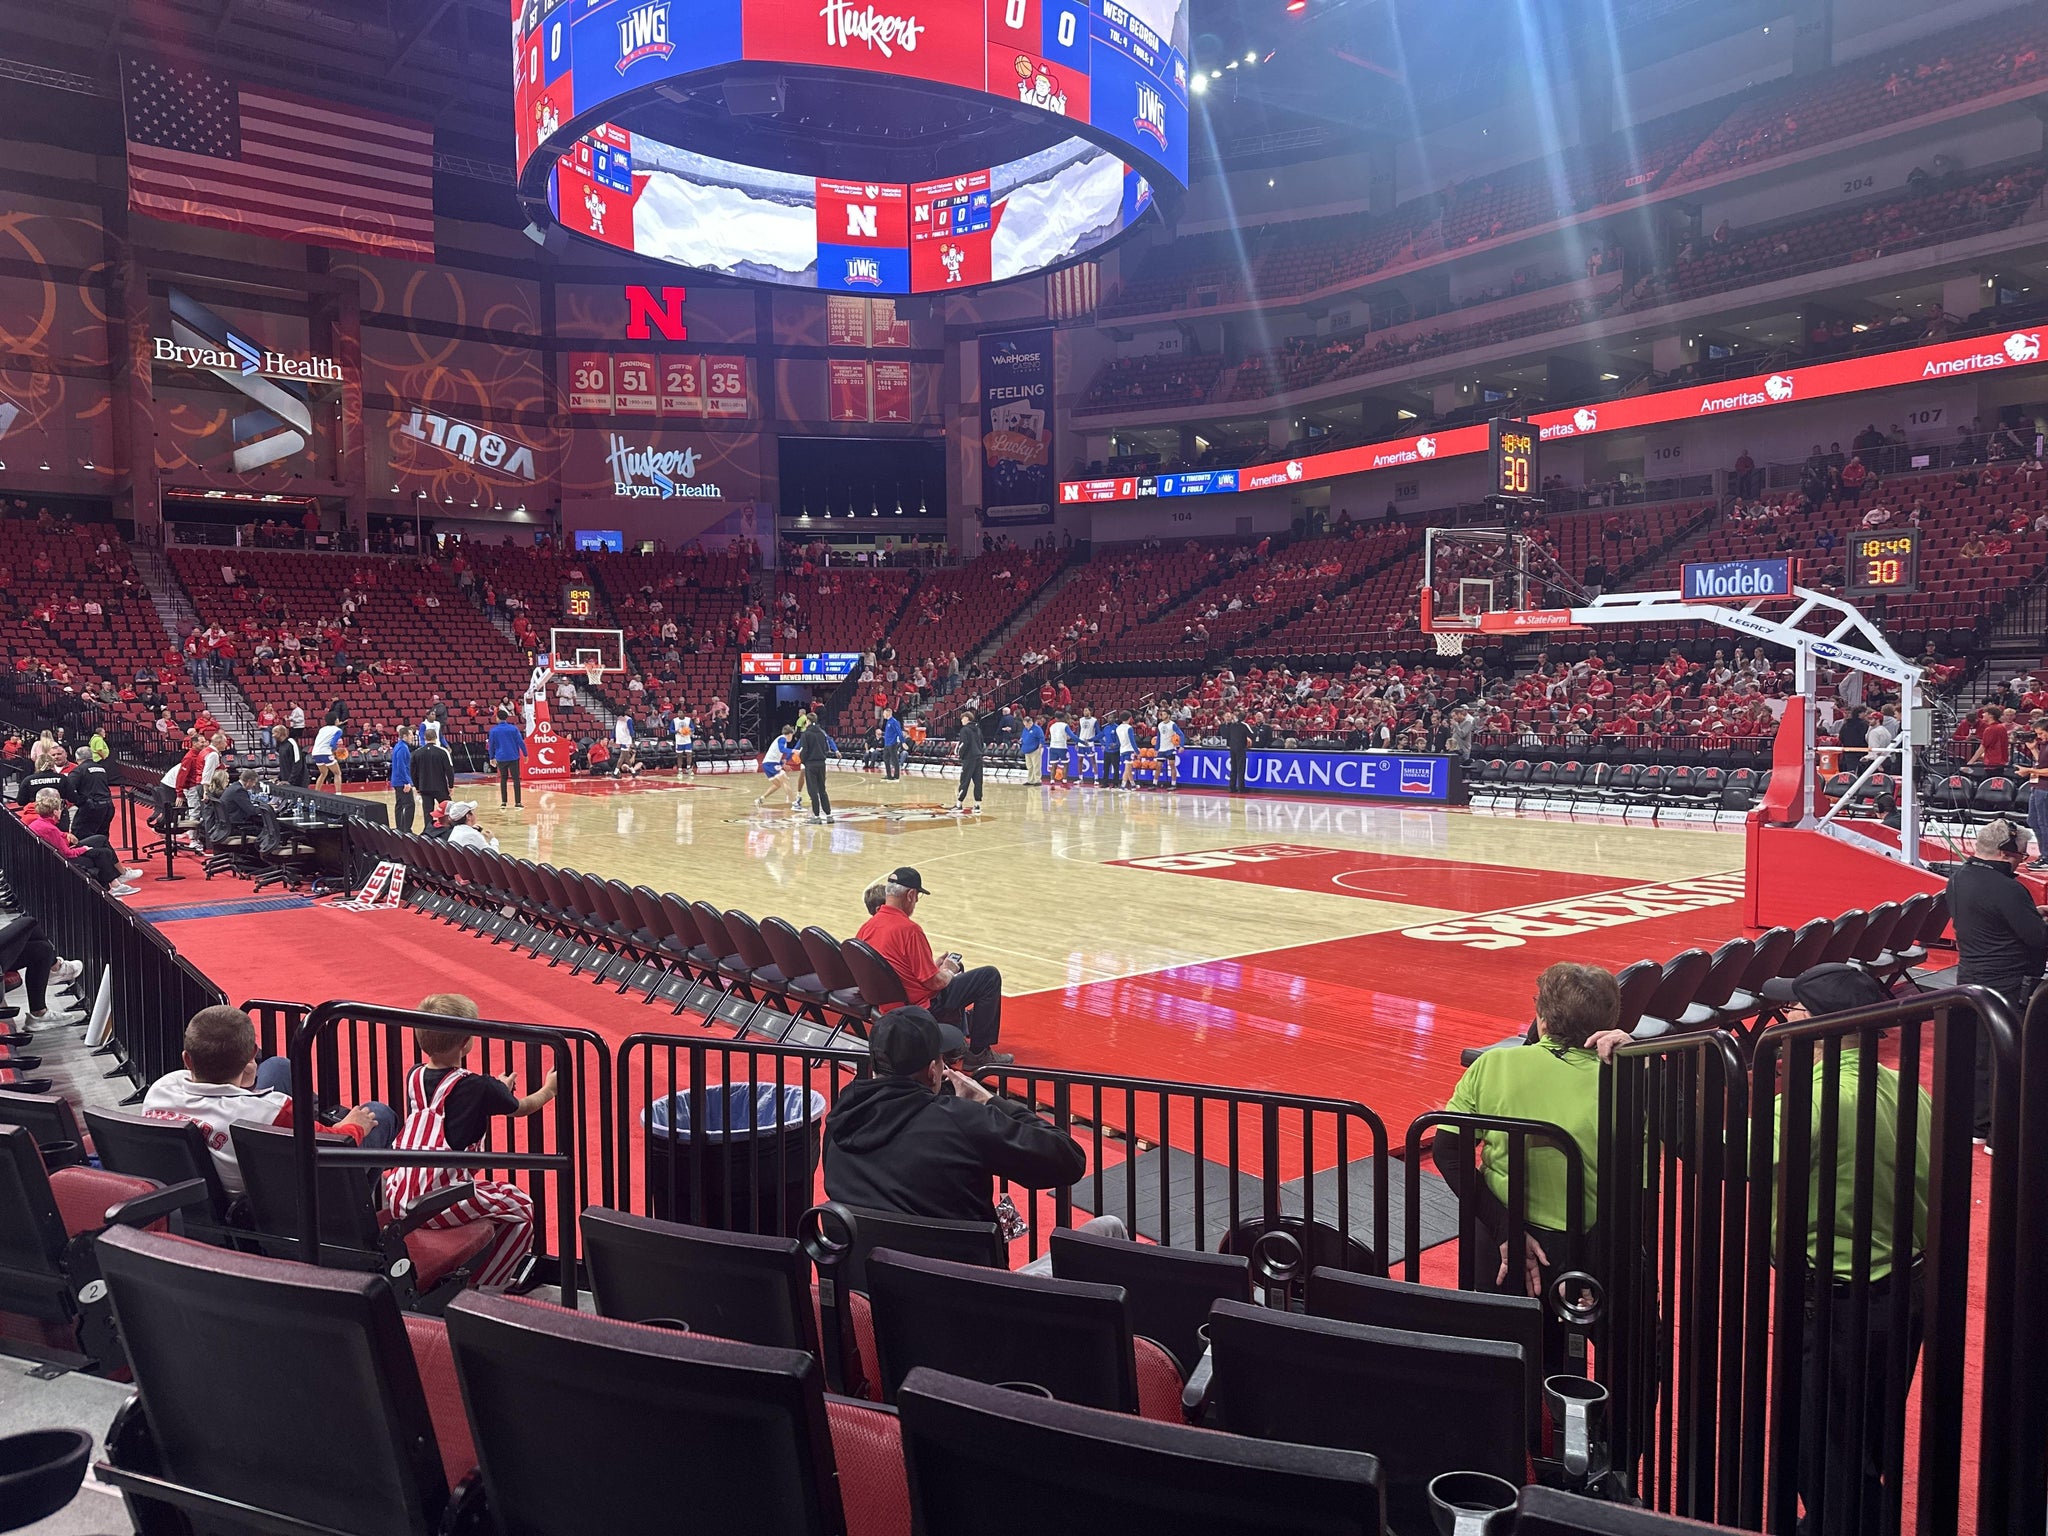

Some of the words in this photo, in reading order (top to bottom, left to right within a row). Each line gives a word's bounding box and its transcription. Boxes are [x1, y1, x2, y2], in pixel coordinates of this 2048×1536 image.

[621, 5, 666, 56] UWG
[819, 0, 925, 58] Huskers
[1057, 10, 1076, 47] 0
[1102, 0, 1127, 28] WEST
[1129, 13, 1159, 53] GEORGIA
[531, 46, 537, 84] 0
[551, 22, 562, 61] 0
[1138, 87, 1165, 134] UWG
[581, 148, 589, 163] 0
[598, 155, 606, 170] 0
[1844, 175, 1874, 193] 204
[914, 204, 929, 222] N
[938, 211, 947, 225] 0
[957, 207, 966, 222] 0
[846, 204, 878, 238] N
[848, 259, 877, 278] UWG
[625, 285, 688, 341] N
[1158, 340, 1178, 350] 201
[153, 337, 237, 369] Bryan
[264, 351, 344, 381] Health
[619, 361, 651, 369] JENNINGS
[991, 352, 1041, 365] WARHORSE
[1922, 353, 2004, 377] Ameritas
[713, 363, 738, 371] HOOPER
[575, 369, 604, 390] 30
[623, 370, 648, 392] 51
[667, 372, 696, 393] 23
[711, 373, 741, 394] 35
[989, 384, 1045, 400] FEELING
[571, 396, 582, 406] N
[617, 397, 627, 407] N
[664, 398, 674, 408] N
[710, 400, 720, 409] N
[1700, 391, 1766, 413] Ameritas
[1908, 408, 1943, 426] 107
[1540, 424, 1574, 438] eritas
[991, 434, 1044, 463] Lucky?
[1654, 445, 1681, 460] 106
[605, 432, 702, 486] Huskers
[1373, 450, 1417, 467] Ameritas
[1250, 472, 1287, 488] Ameritas
[1504, 456, 1528, 492] 30
[614, 482, 660, 499] Bryan
[674, 483, 722, 498] Health
[1122, 482, 1132, 495] 0
[1142, 479, 1153, 487] 1ST
[1163, 478, 1174, 493] 0
[1186, 485, 1203, 493] FOULS
[1064, 485, 1079, 500] N
[1171, 512, 1193, 522] 104
[1862, 537, 1912, 558] 18:49
[1719, 563, 1749, 571] CERVEZA
[1867, 559, 1898, 585] 30
[1695, 568, 1773, 596] Modelo
[570, 590, 590, 599] 18:49
[571, 600, 589, 615] 30
[1728, 616, 1775, 634] LEGACY
[744, 661, 755, 672] N
[789, 661, 797, 671] 0
[809, 661, 817, 671] 0
[1842, 652, 1898, 675] SPORTS
[534, 734, 557, 744] fnbo
[528, 765, 566, 775] Channel
[1515, 760, 1524, 769] N
[1566, 761, 1577, 772] N
[1621, 763, 1632, 774] N
[1650, 765, 1660, 776] N
[1677, 766, 1688, 777] N
[1706, 768, 1718, 779] N
[1737, 768, 1748, 779] N
[1837, 772, 1849, 784] N
[1872, 773, 1884, 785] N
[30, 777, 61, 786] SECURITY
[1950, 776, 1962, 787] N
[1991, 777, 2004, 790] N
[1401, 869, 1746, 950] USKERS
[397, 1263, 404, 1275] 1
[88, 1284, 99, 1298] 2
